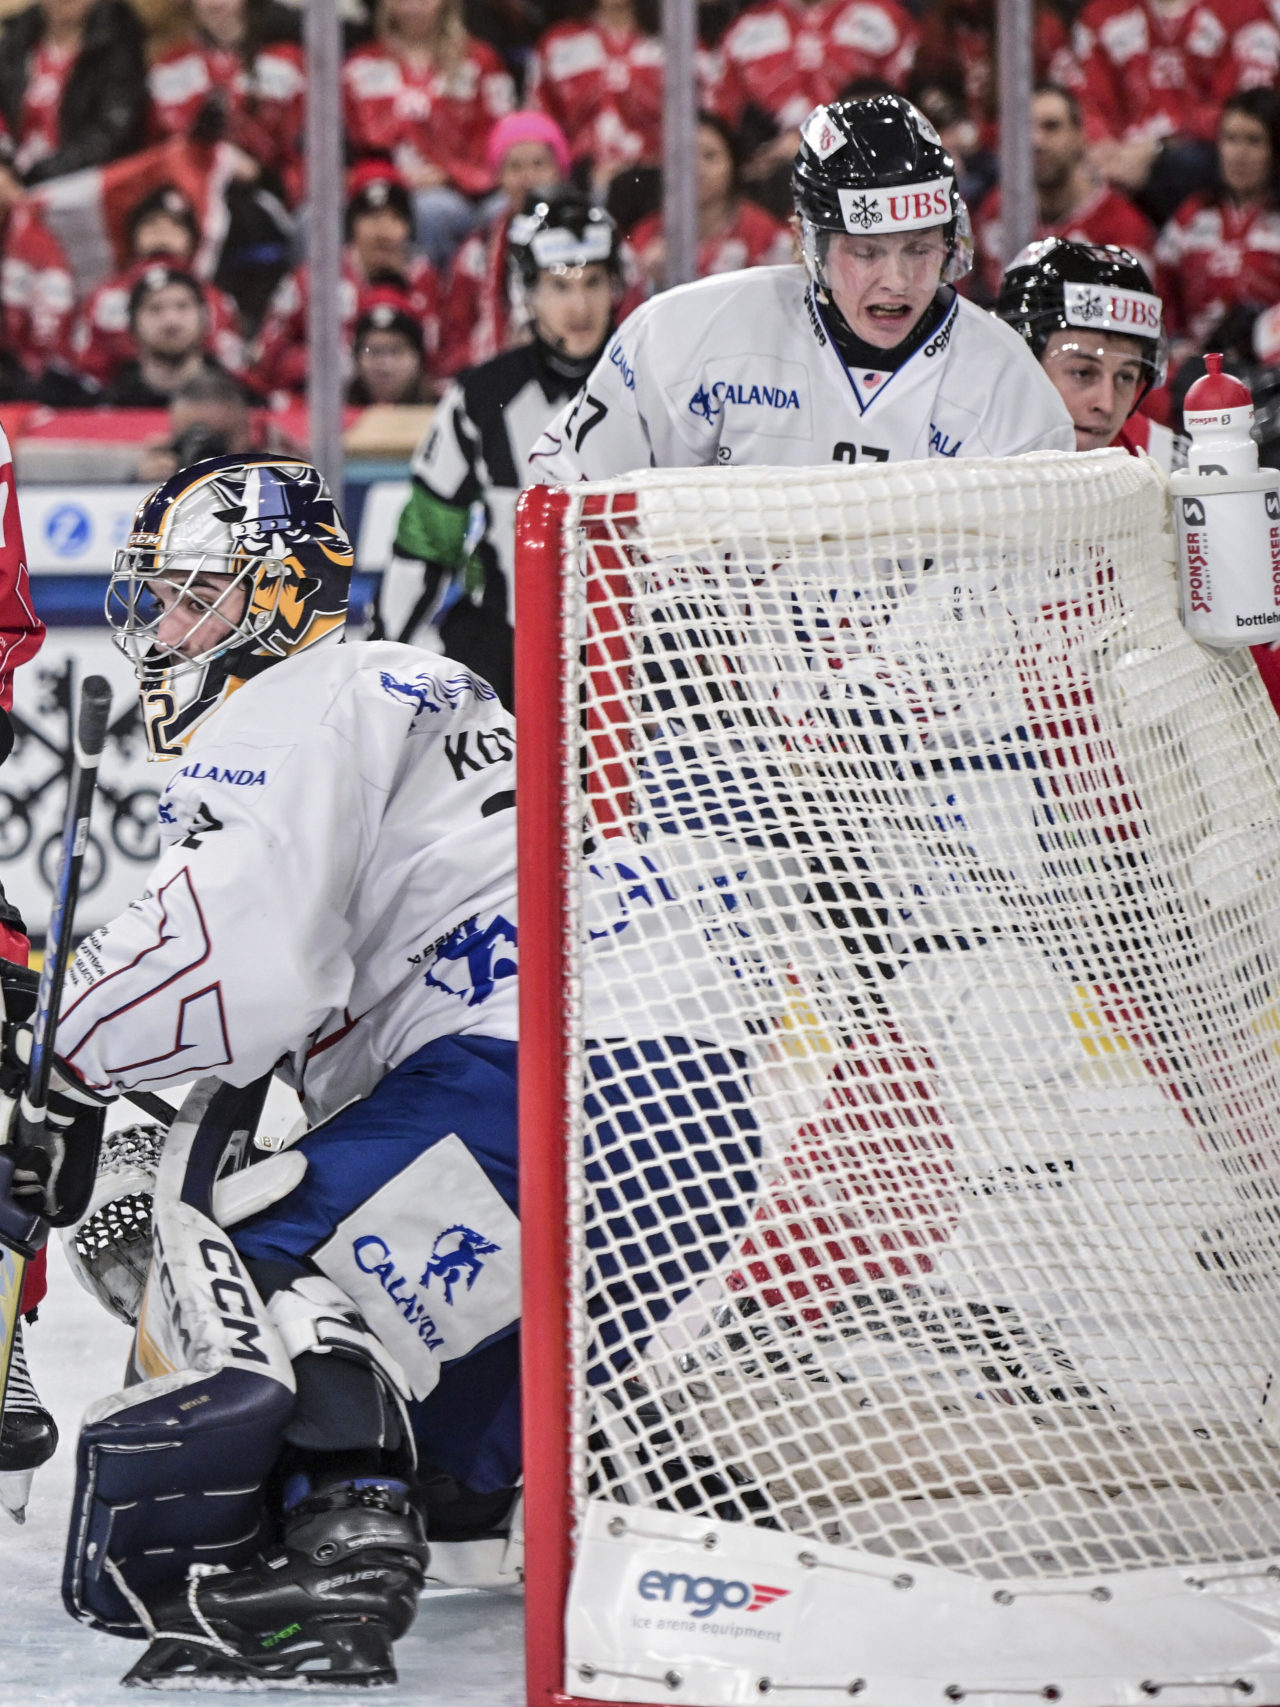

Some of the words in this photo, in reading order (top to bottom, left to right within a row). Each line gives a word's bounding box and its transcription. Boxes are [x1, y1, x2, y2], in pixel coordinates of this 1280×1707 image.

[887, 188, 948, 222] UBS
[1110, 296, 1159, 329] UBS
[710, 381, 801, 414] CALANDA
[129, 534, 163, 545] CCM
[1187, 532, 1212, 613] SPONSER
[199, 1238, 271, 1366] CCM
[638, 1569, 751, 1619] engo
[632, 1616, 652, 1630] ice
[657, 1618, 697, 1633] arena
[701, 1621, 782, 1643] equipment
